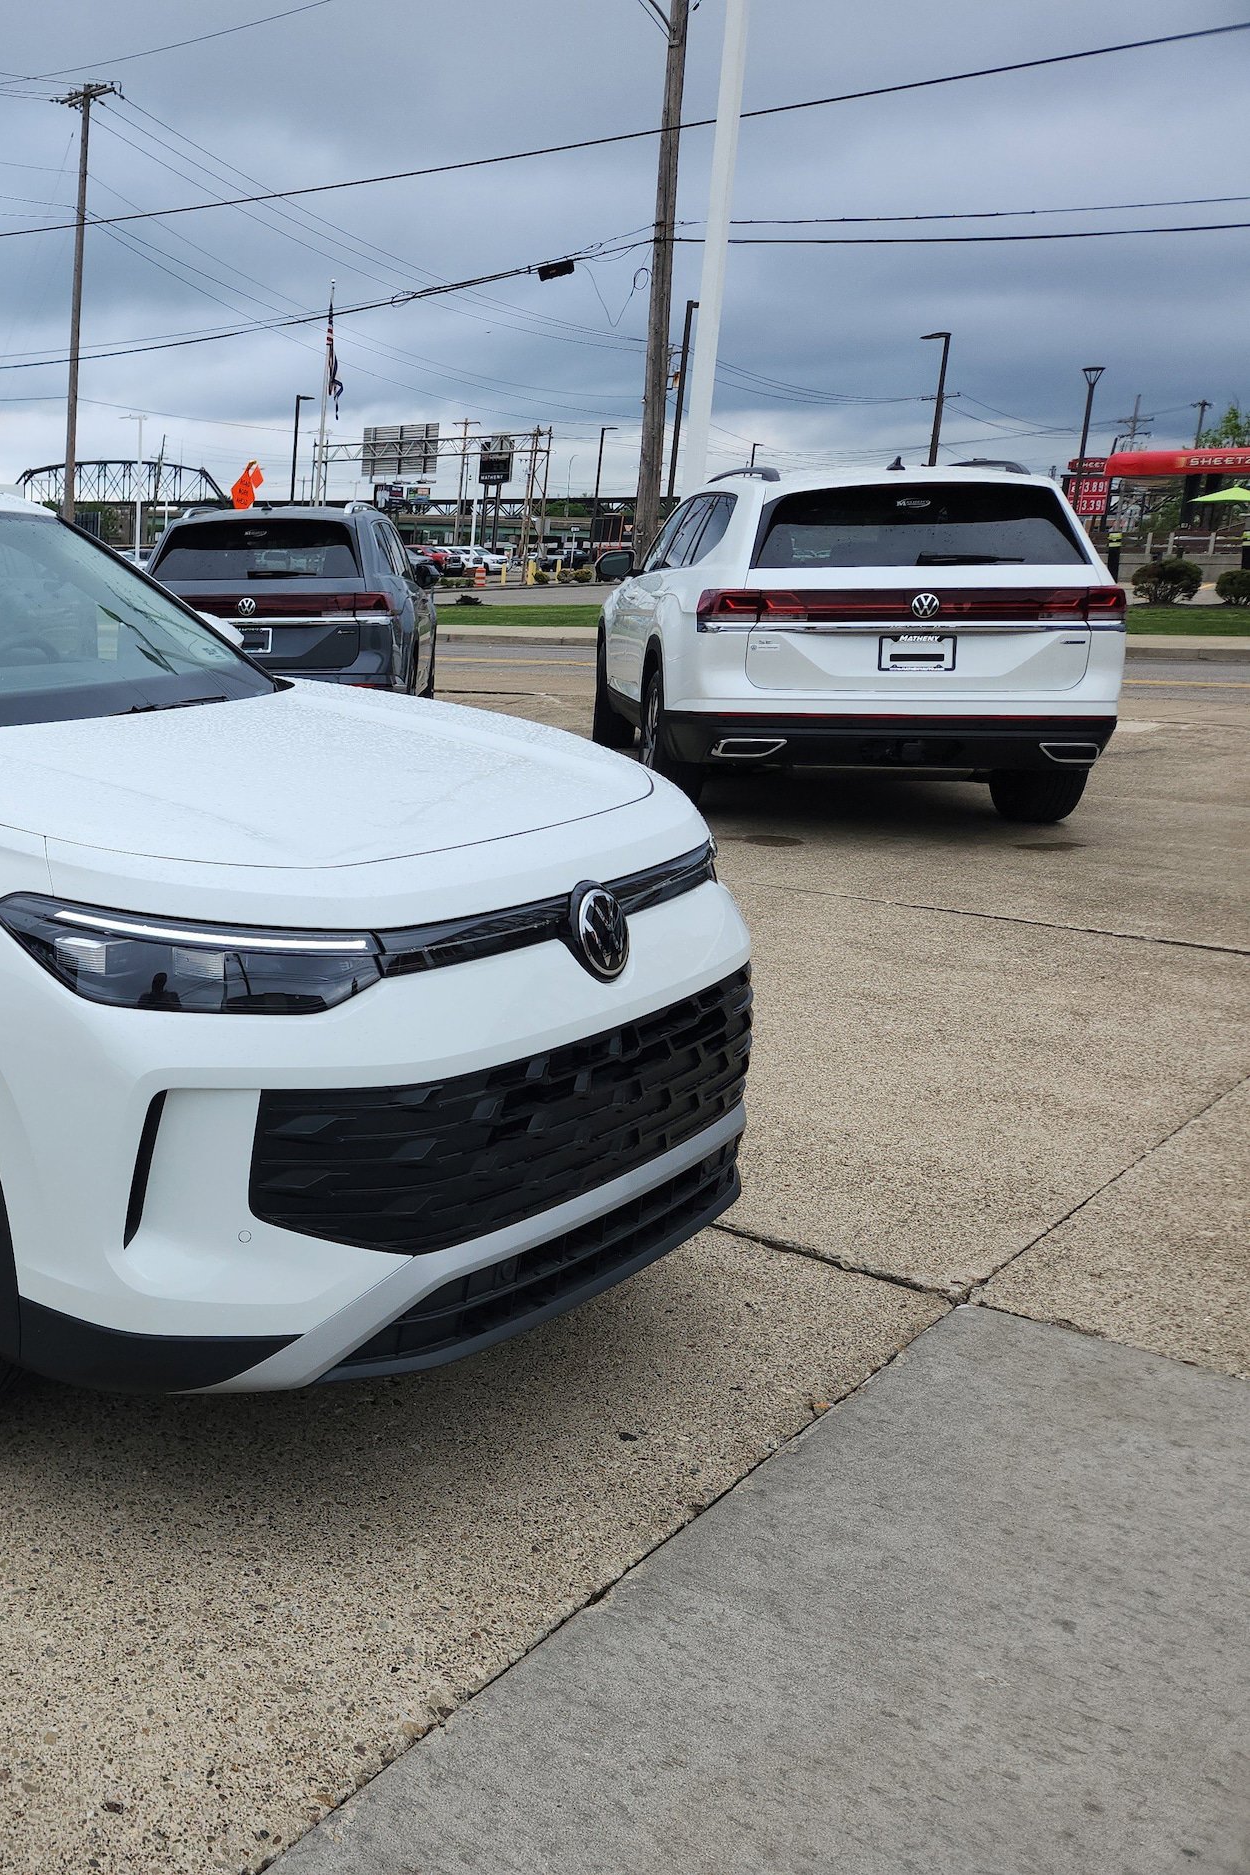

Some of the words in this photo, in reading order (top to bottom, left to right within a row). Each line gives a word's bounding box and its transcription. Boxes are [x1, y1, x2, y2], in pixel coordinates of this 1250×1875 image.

[1083, 481, 1104, 493] 3.89
[1081, 500, 1102, 511] 3.39
[899, 634, 941, 643] MATHENY
